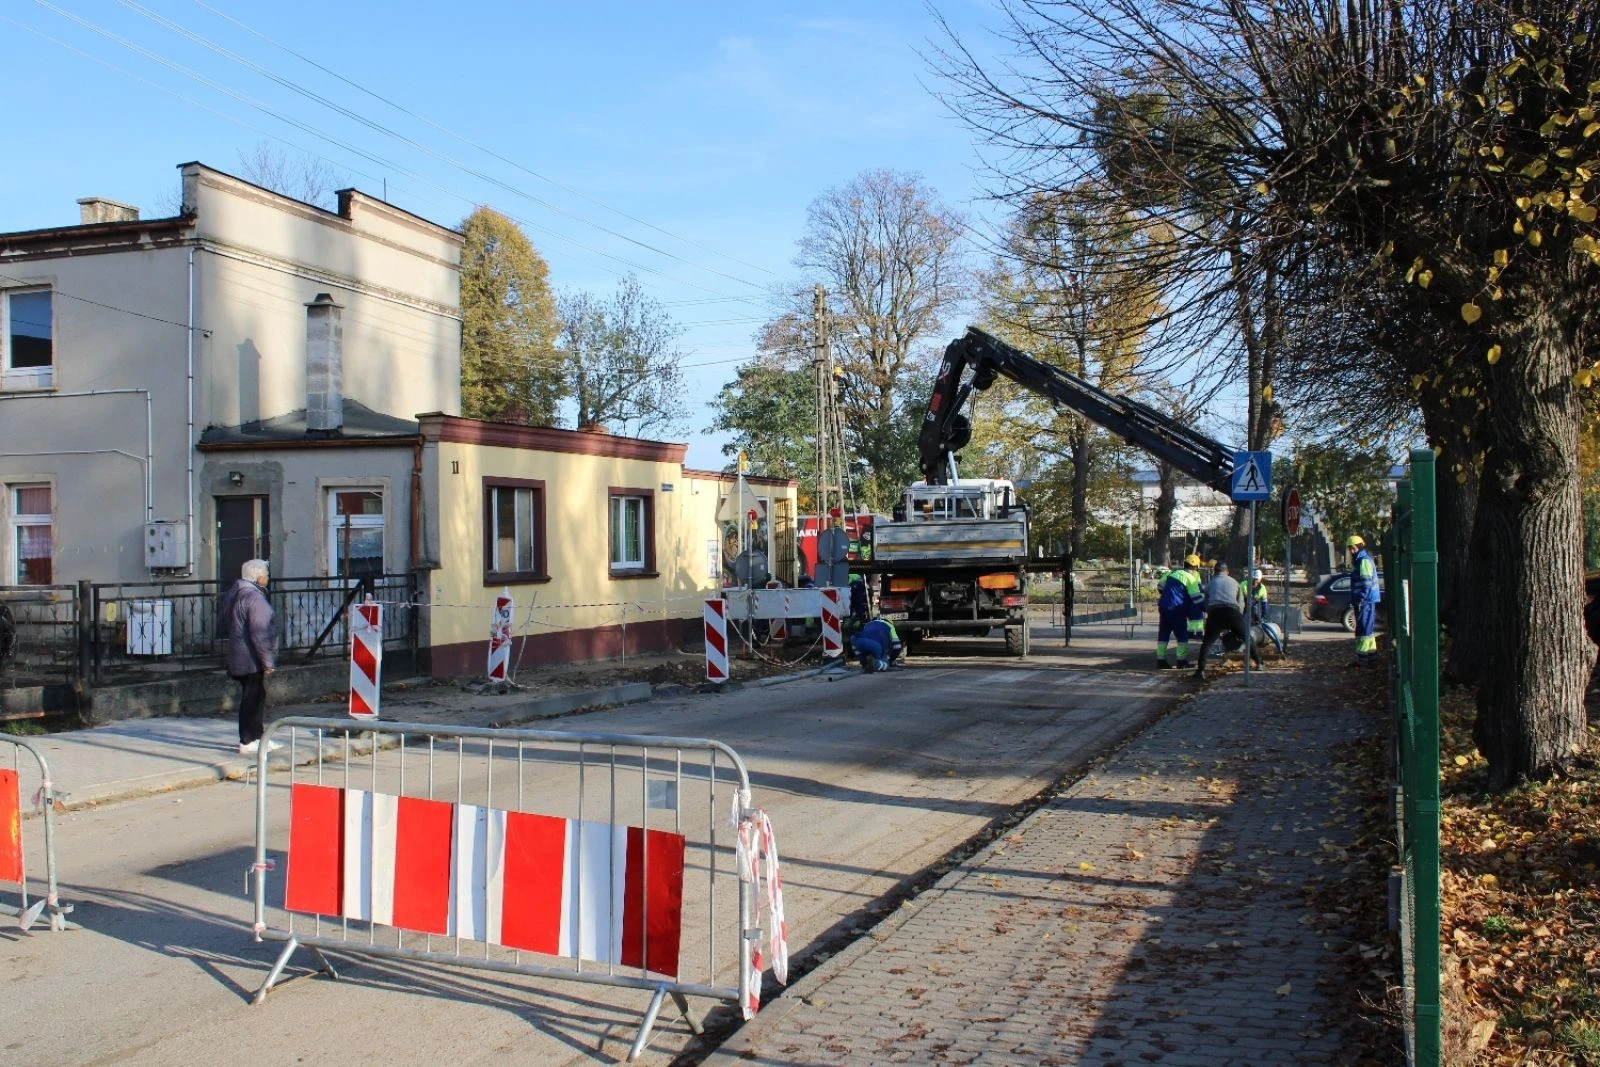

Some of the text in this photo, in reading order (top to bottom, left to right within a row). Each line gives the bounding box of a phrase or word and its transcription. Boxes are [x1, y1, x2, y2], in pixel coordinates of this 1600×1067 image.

[451, 460, 460, 475] 11
[1288, 504, 1299, 520] STOP
[797, 528, 818, 537] AKU
